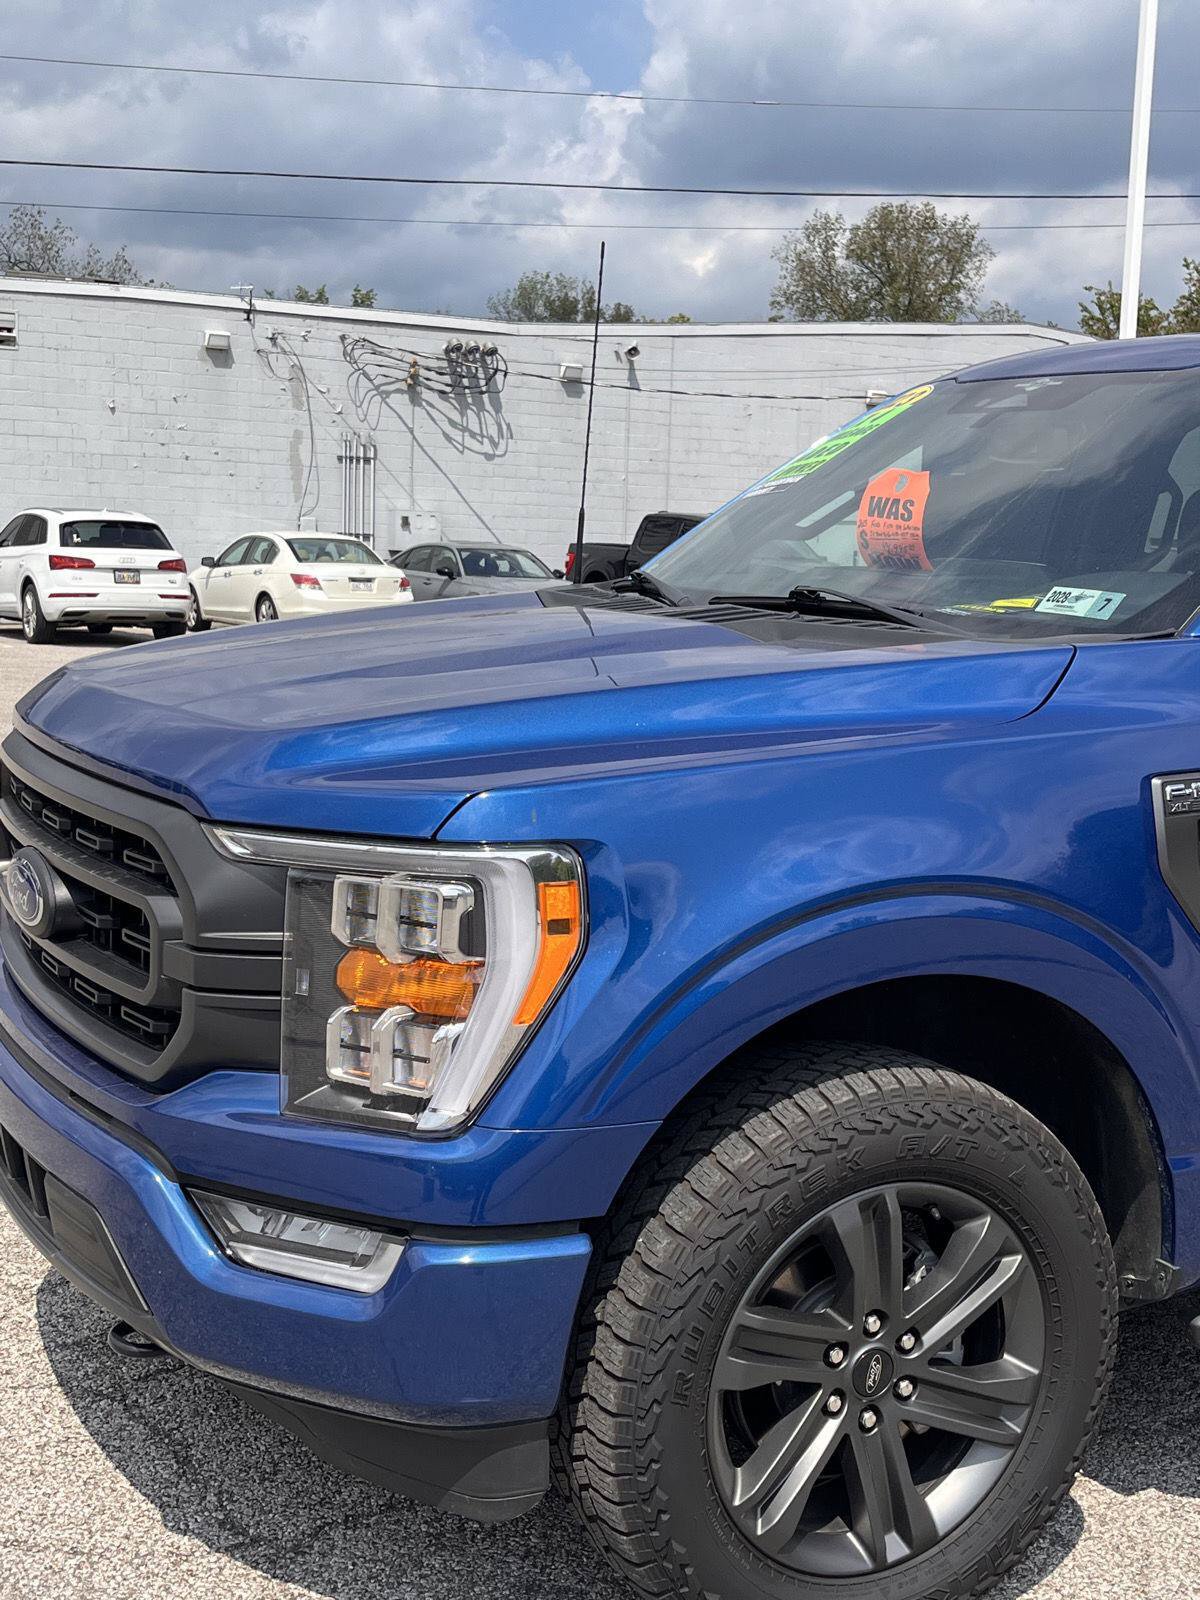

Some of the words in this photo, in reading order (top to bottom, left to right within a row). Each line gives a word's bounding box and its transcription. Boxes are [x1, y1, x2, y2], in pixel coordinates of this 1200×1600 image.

[867, 495, 915, 522] WAS
[1046, 590, 1072, 604] 2028
[1097, 598, 1113, 612] 7
[1165, 782, 1200, 801] F-1
[671, 1146, 866, 1408] RUBITREK
[867, 1359, 881, 1389] Ford
